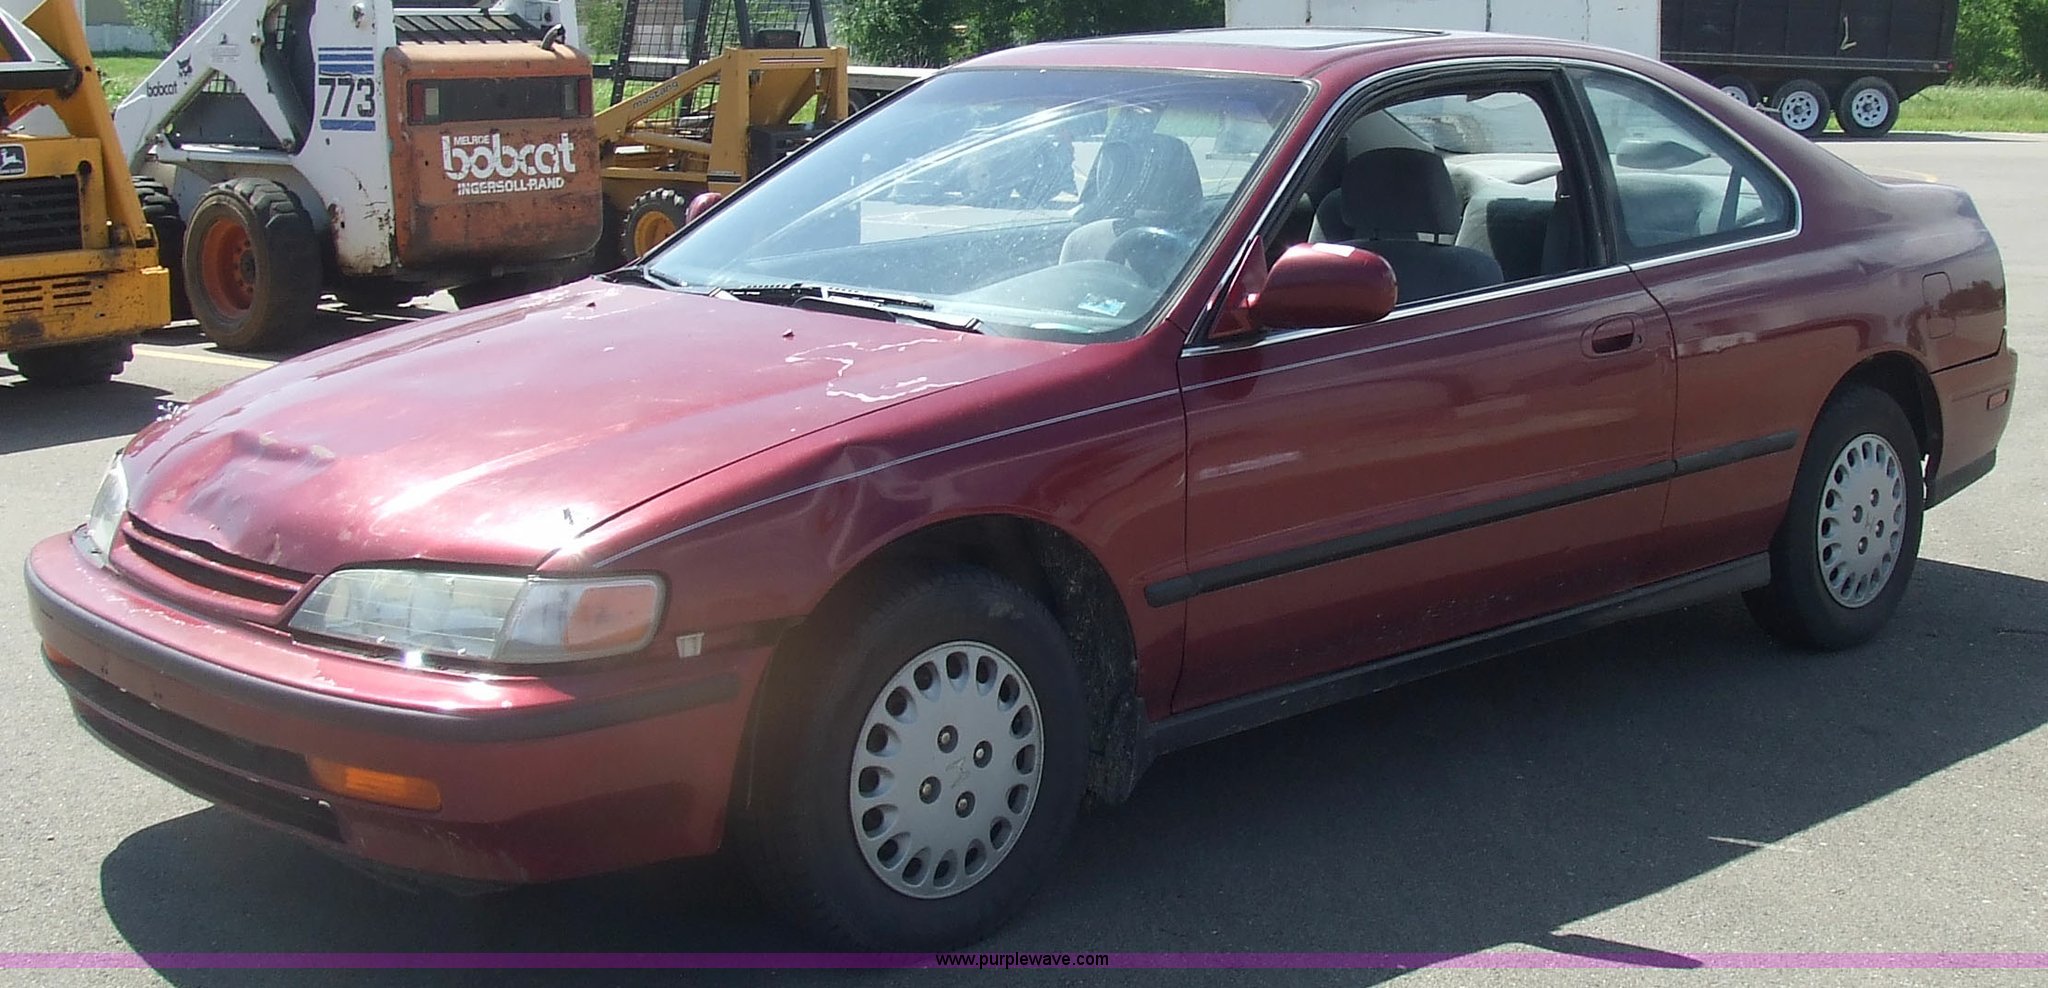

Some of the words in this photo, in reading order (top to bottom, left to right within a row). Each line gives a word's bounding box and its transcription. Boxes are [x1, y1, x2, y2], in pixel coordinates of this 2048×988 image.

[146, 81, 177, 97] bobcat
[318, 77, 375, 117] 773
[633, 81, 679, 109] mustang
[454, 135, 490, 146] MELROE
[442, 133, 576, 180] bobcat
